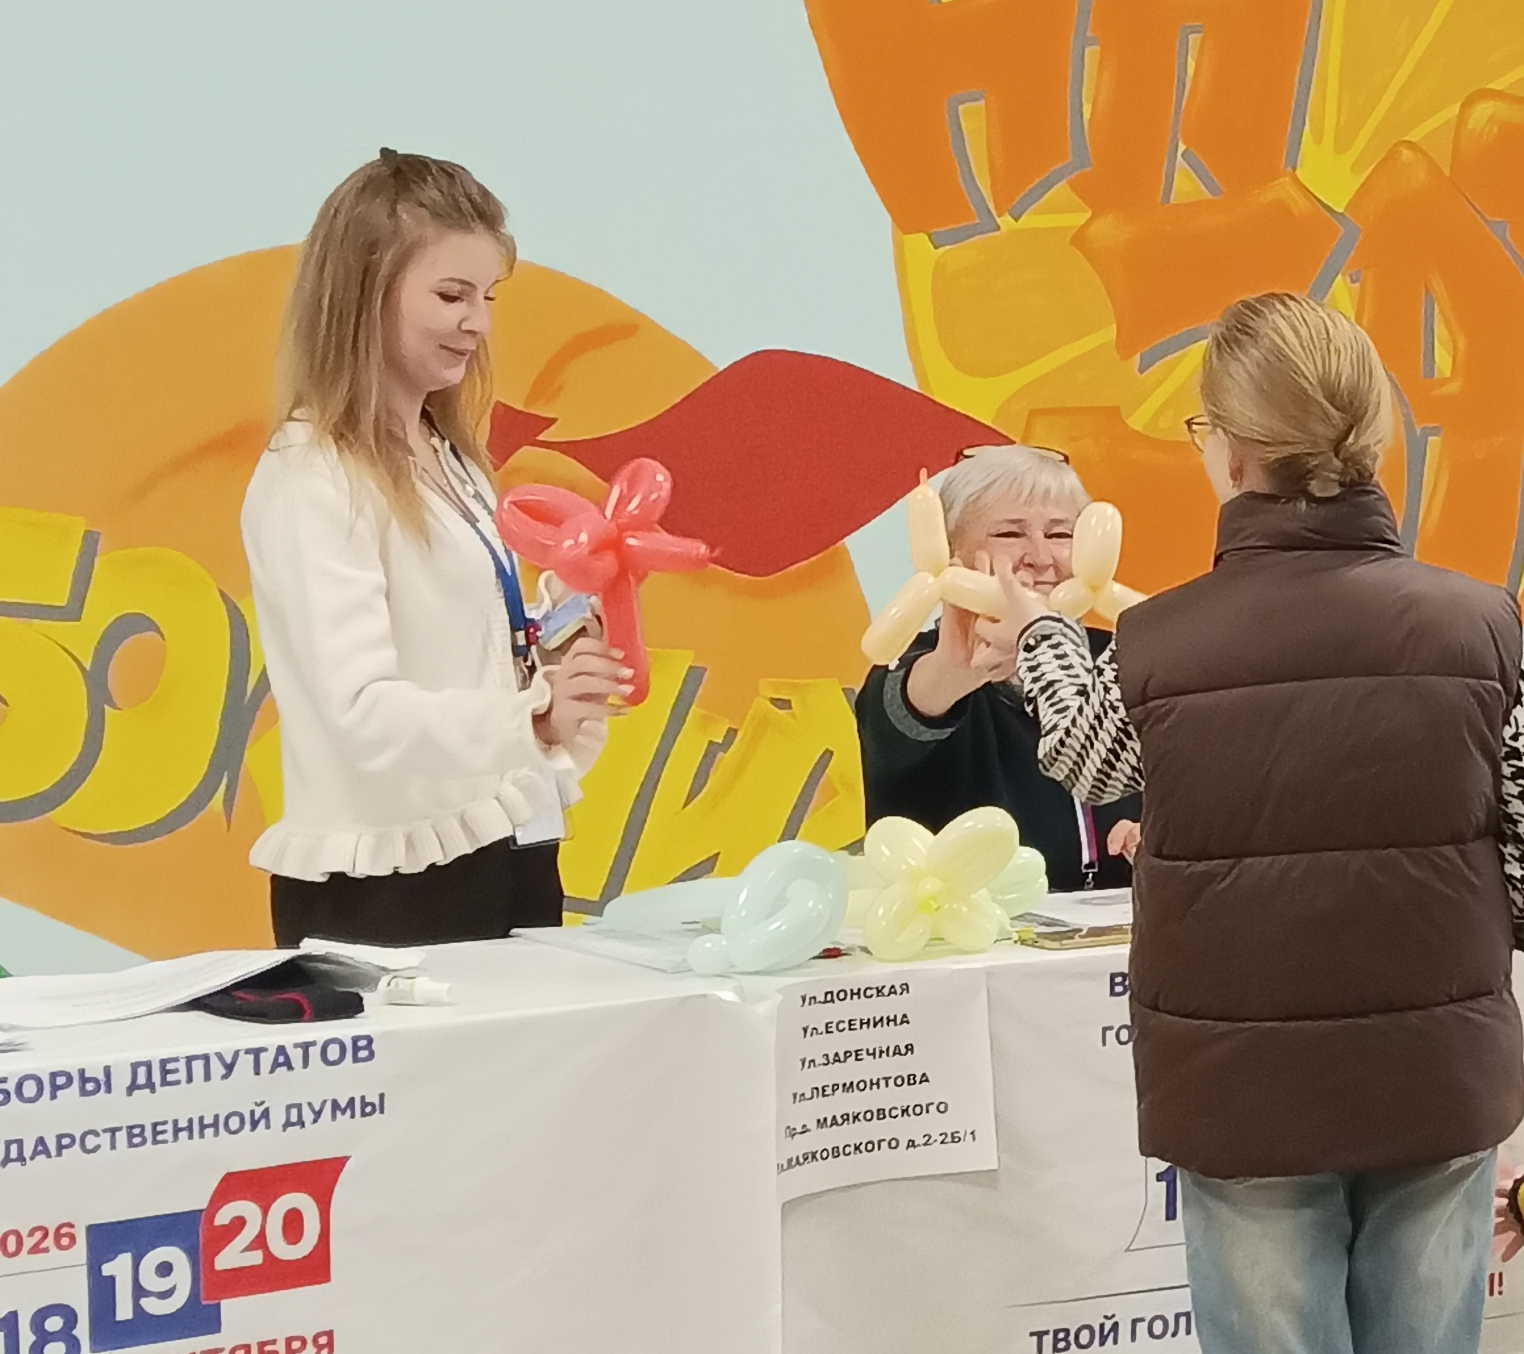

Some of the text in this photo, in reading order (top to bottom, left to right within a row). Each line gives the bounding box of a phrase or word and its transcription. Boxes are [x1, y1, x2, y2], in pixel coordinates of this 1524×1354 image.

[800, 982, 910, 1007] Ул.ДОНСКАЯ
[802, 1013, 911, 1039] Ул.ЕСЕНИНА
[125, 1033, 376, 1097] ДЕПУТАТОВ
[799, 1043, 915, 1071] Ул.ЗАРЕЧНАЯ
[0, 1092, 386, 1168] ДАРСТВЕННОЙ ДУМЫ
[816, 1101, 949, 1130] МАЯКОВСКОГО
[101, 1245, 192, 1322] 19
[213, 1191, 321, 1271] 20
[1131, 1311, 1192, 1343] ГОЛ
